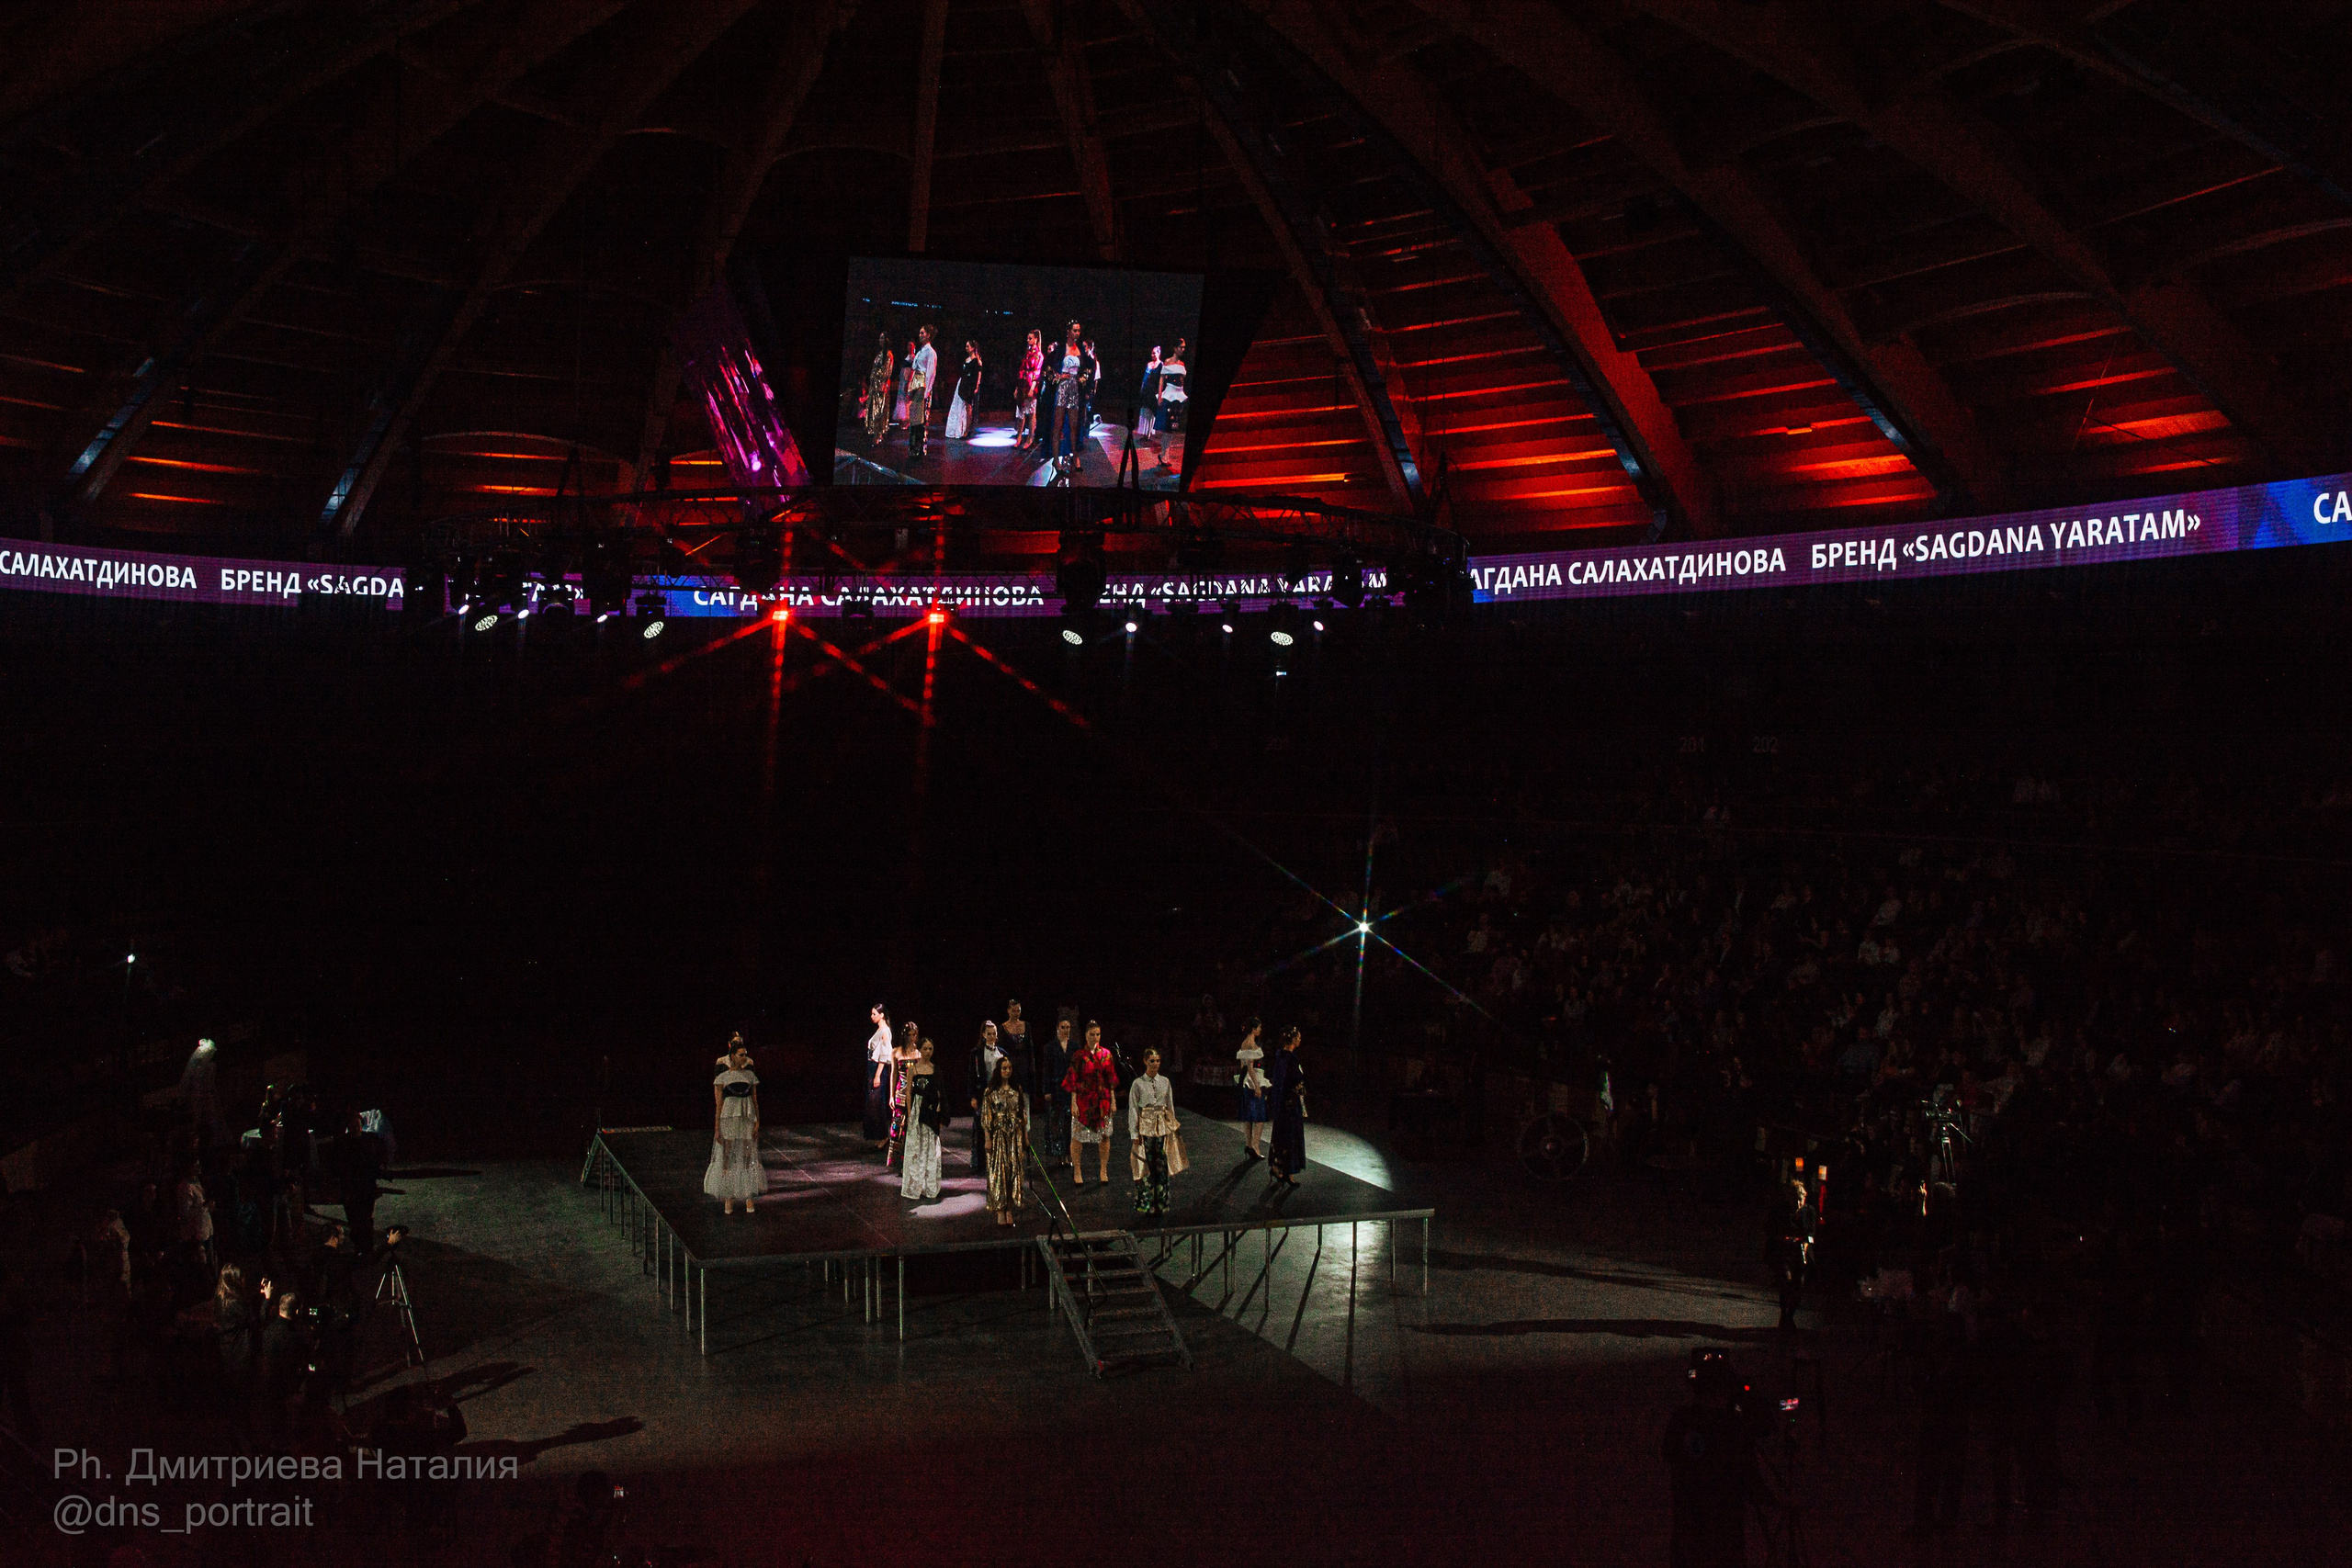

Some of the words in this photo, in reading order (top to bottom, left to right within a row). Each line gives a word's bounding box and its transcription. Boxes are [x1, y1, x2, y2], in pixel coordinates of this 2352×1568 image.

[0, 550, 198, 590] САЛАХАТДИНОВА
[220, 568, 302, 599] БРЕНД
[307, 574, 404, 598] «SAGDA
[1469, 563, 1563, 595] АГДАНА
[1567, 547, 1787, 585] САЛАХАТДИНОВА
[1812, 537, 1897, 571] БРЕНД
[1902, 525, 2044, 562] «SAGDANA
[2049, 509, 2201, 549] YARATAM»
